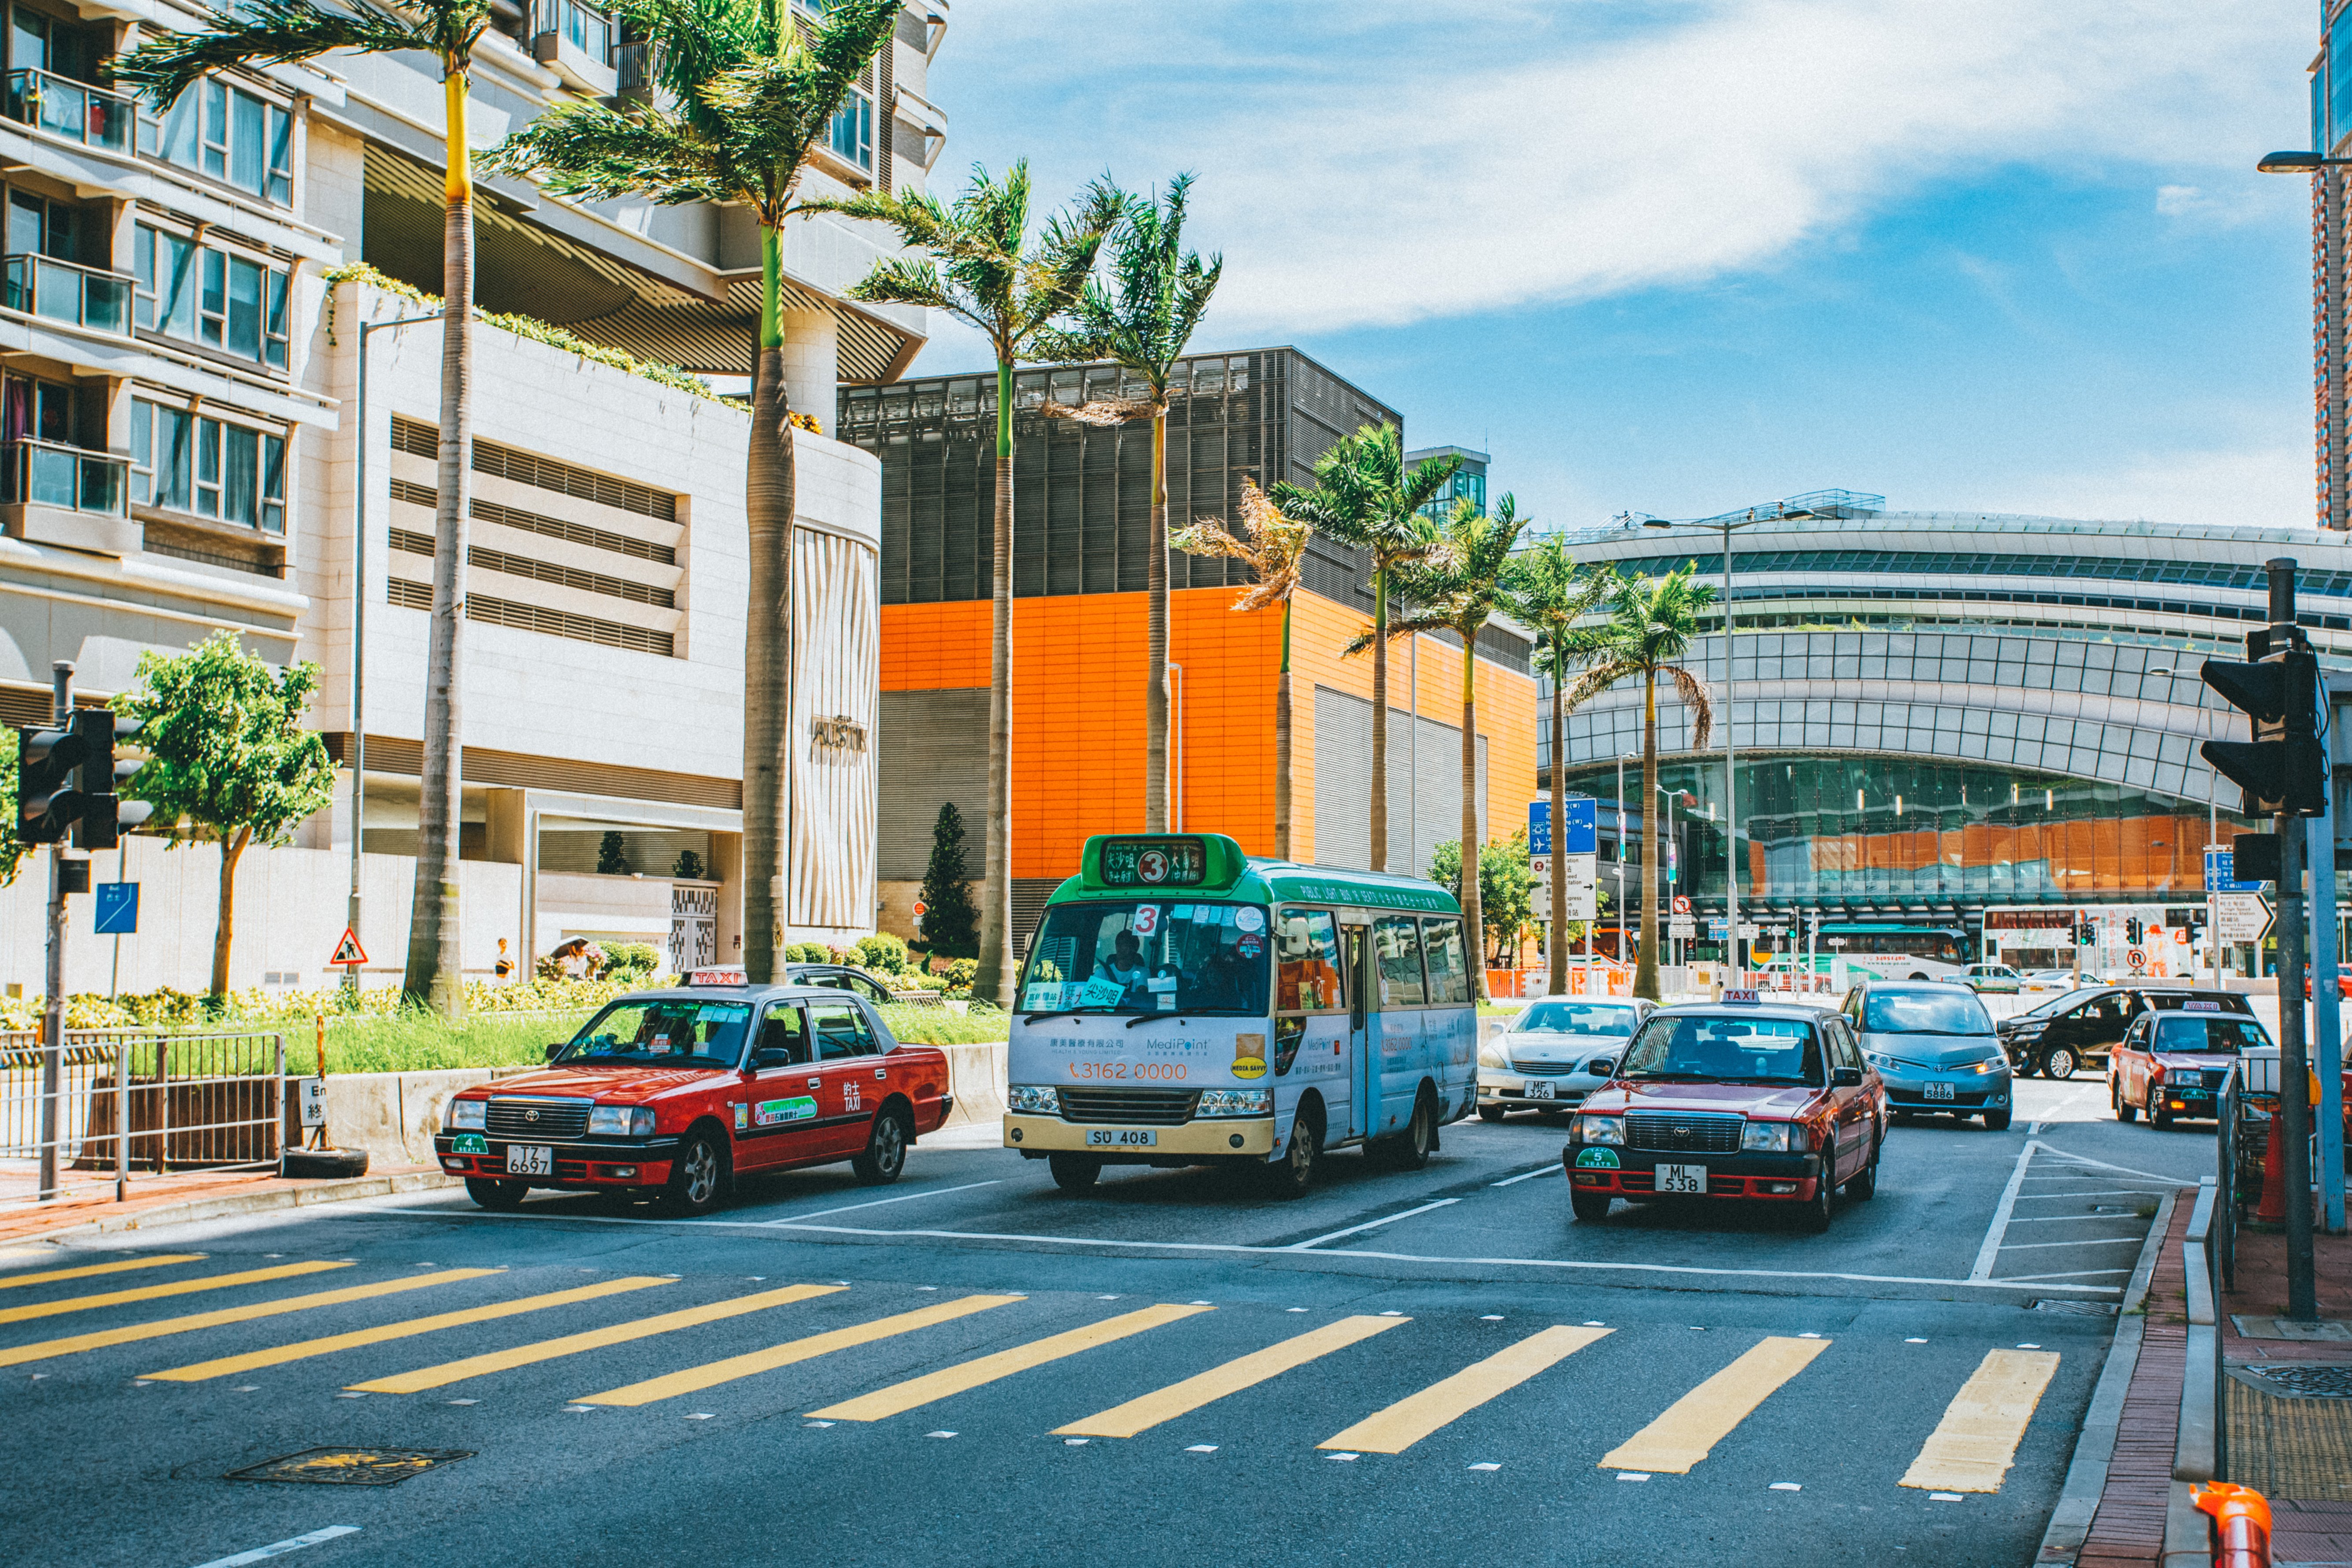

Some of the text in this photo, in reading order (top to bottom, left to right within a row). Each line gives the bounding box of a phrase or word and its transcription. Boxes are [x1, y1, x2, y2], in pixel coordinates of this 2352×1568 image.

[1107, 852, 1135, 869] 尖沙咀
[1144, 854, 1164, 880] 3
[1300, 886, 1321, 899] PUBLIC
[1321, 888, 1339, 900] LIGHT
[1339, 888, 1352, 901] BUS
[1361, 891, 1378, 903] SEATS
[1135, 907, 1156, 932] 3
[696, 973, 738, 983] TAXI
[1085, 983, 1118, 1005] 尖沙咀
[1726, 991, 1755, 1000] TAXI
[1050, 1039, 1123, 1048] 康美醫療有限公司
[1385, 1037, 1412, 1051] 3162 0000
[1081, 1062, 1187, 1080] 3162 0000
[311, 1086, 327, 1096] En
[843, 1080, 859, 1096] 的士
[1530, 1089, 1549, 1098] 326
[1926, 1090, 1952, 1098] 5886
[844, 1096, 860, 1111] TAXI
[308, 1104, 322, 1119] 終
[465, 1138, 473, 1146] 4
[1093, 1131, 1148, 1144] SU 408
[521, 1146, 539, 1160] TZ
[510, 1159, 548, 1174] 6697
[1670, 1165, 1692, 1178] ML
[1665, 1178, 1698, 1192] 538
